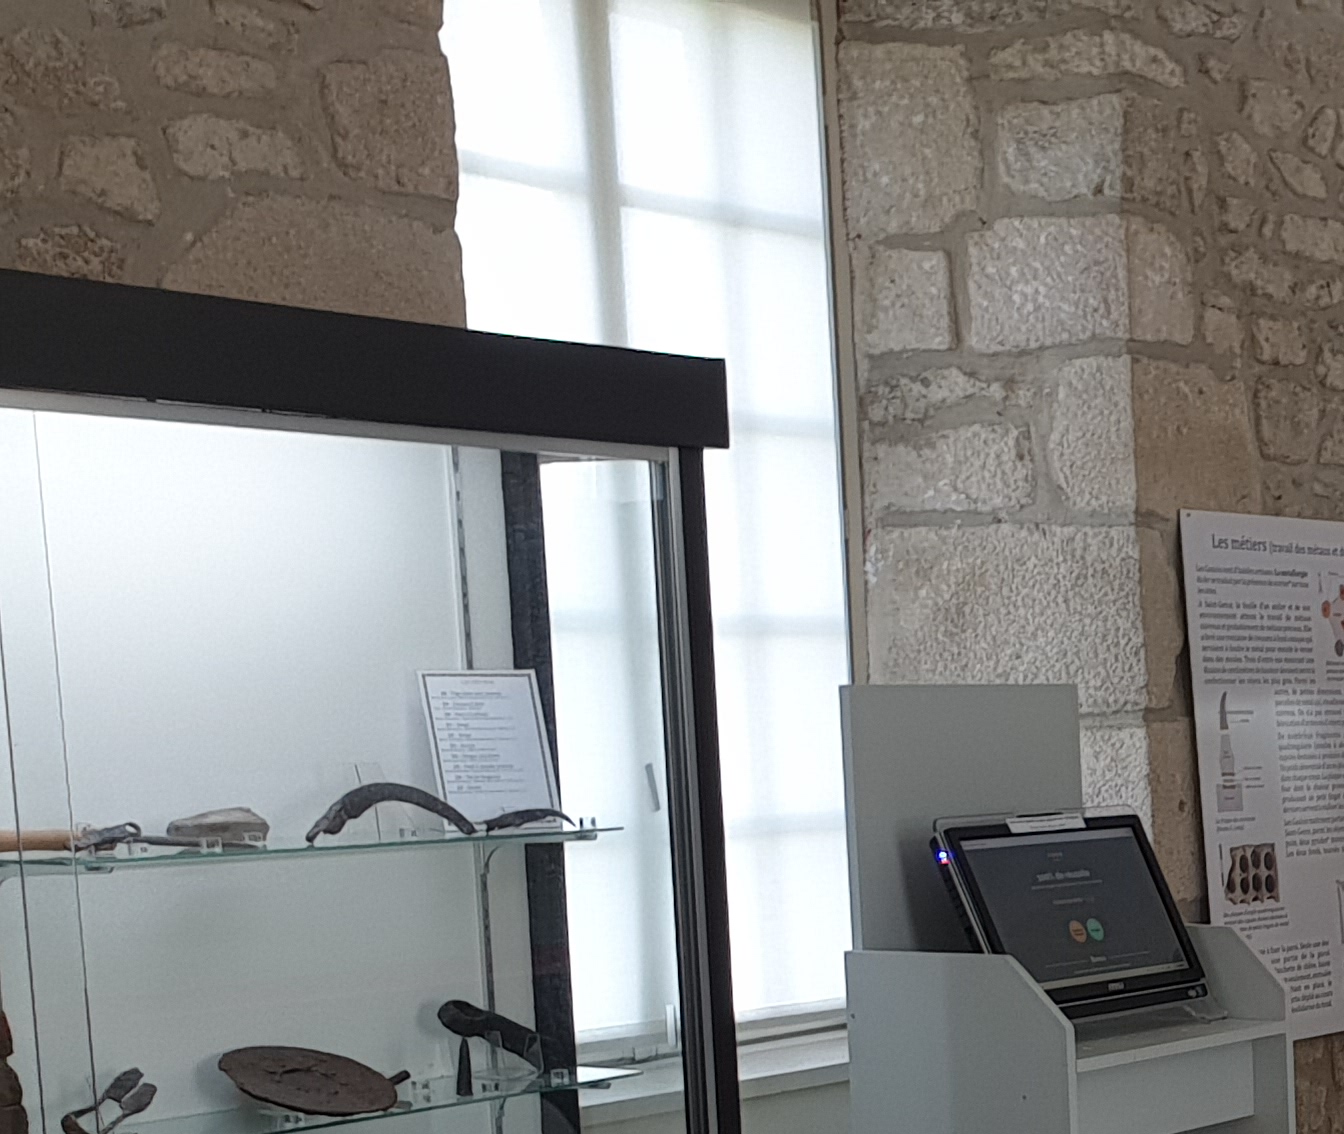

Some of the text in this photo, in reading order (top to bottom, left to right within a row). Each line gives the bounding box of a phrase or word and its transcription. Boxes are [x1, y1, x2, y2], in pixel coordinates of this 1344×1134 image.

[1212, 534, 1229, 550] Les
[1231, 536, 1267, 552] métiers
[1294, 543, 1306, 554] des
[1307, 543, 1331, 556] métaux
[1331, 545, 1338, 556] et
